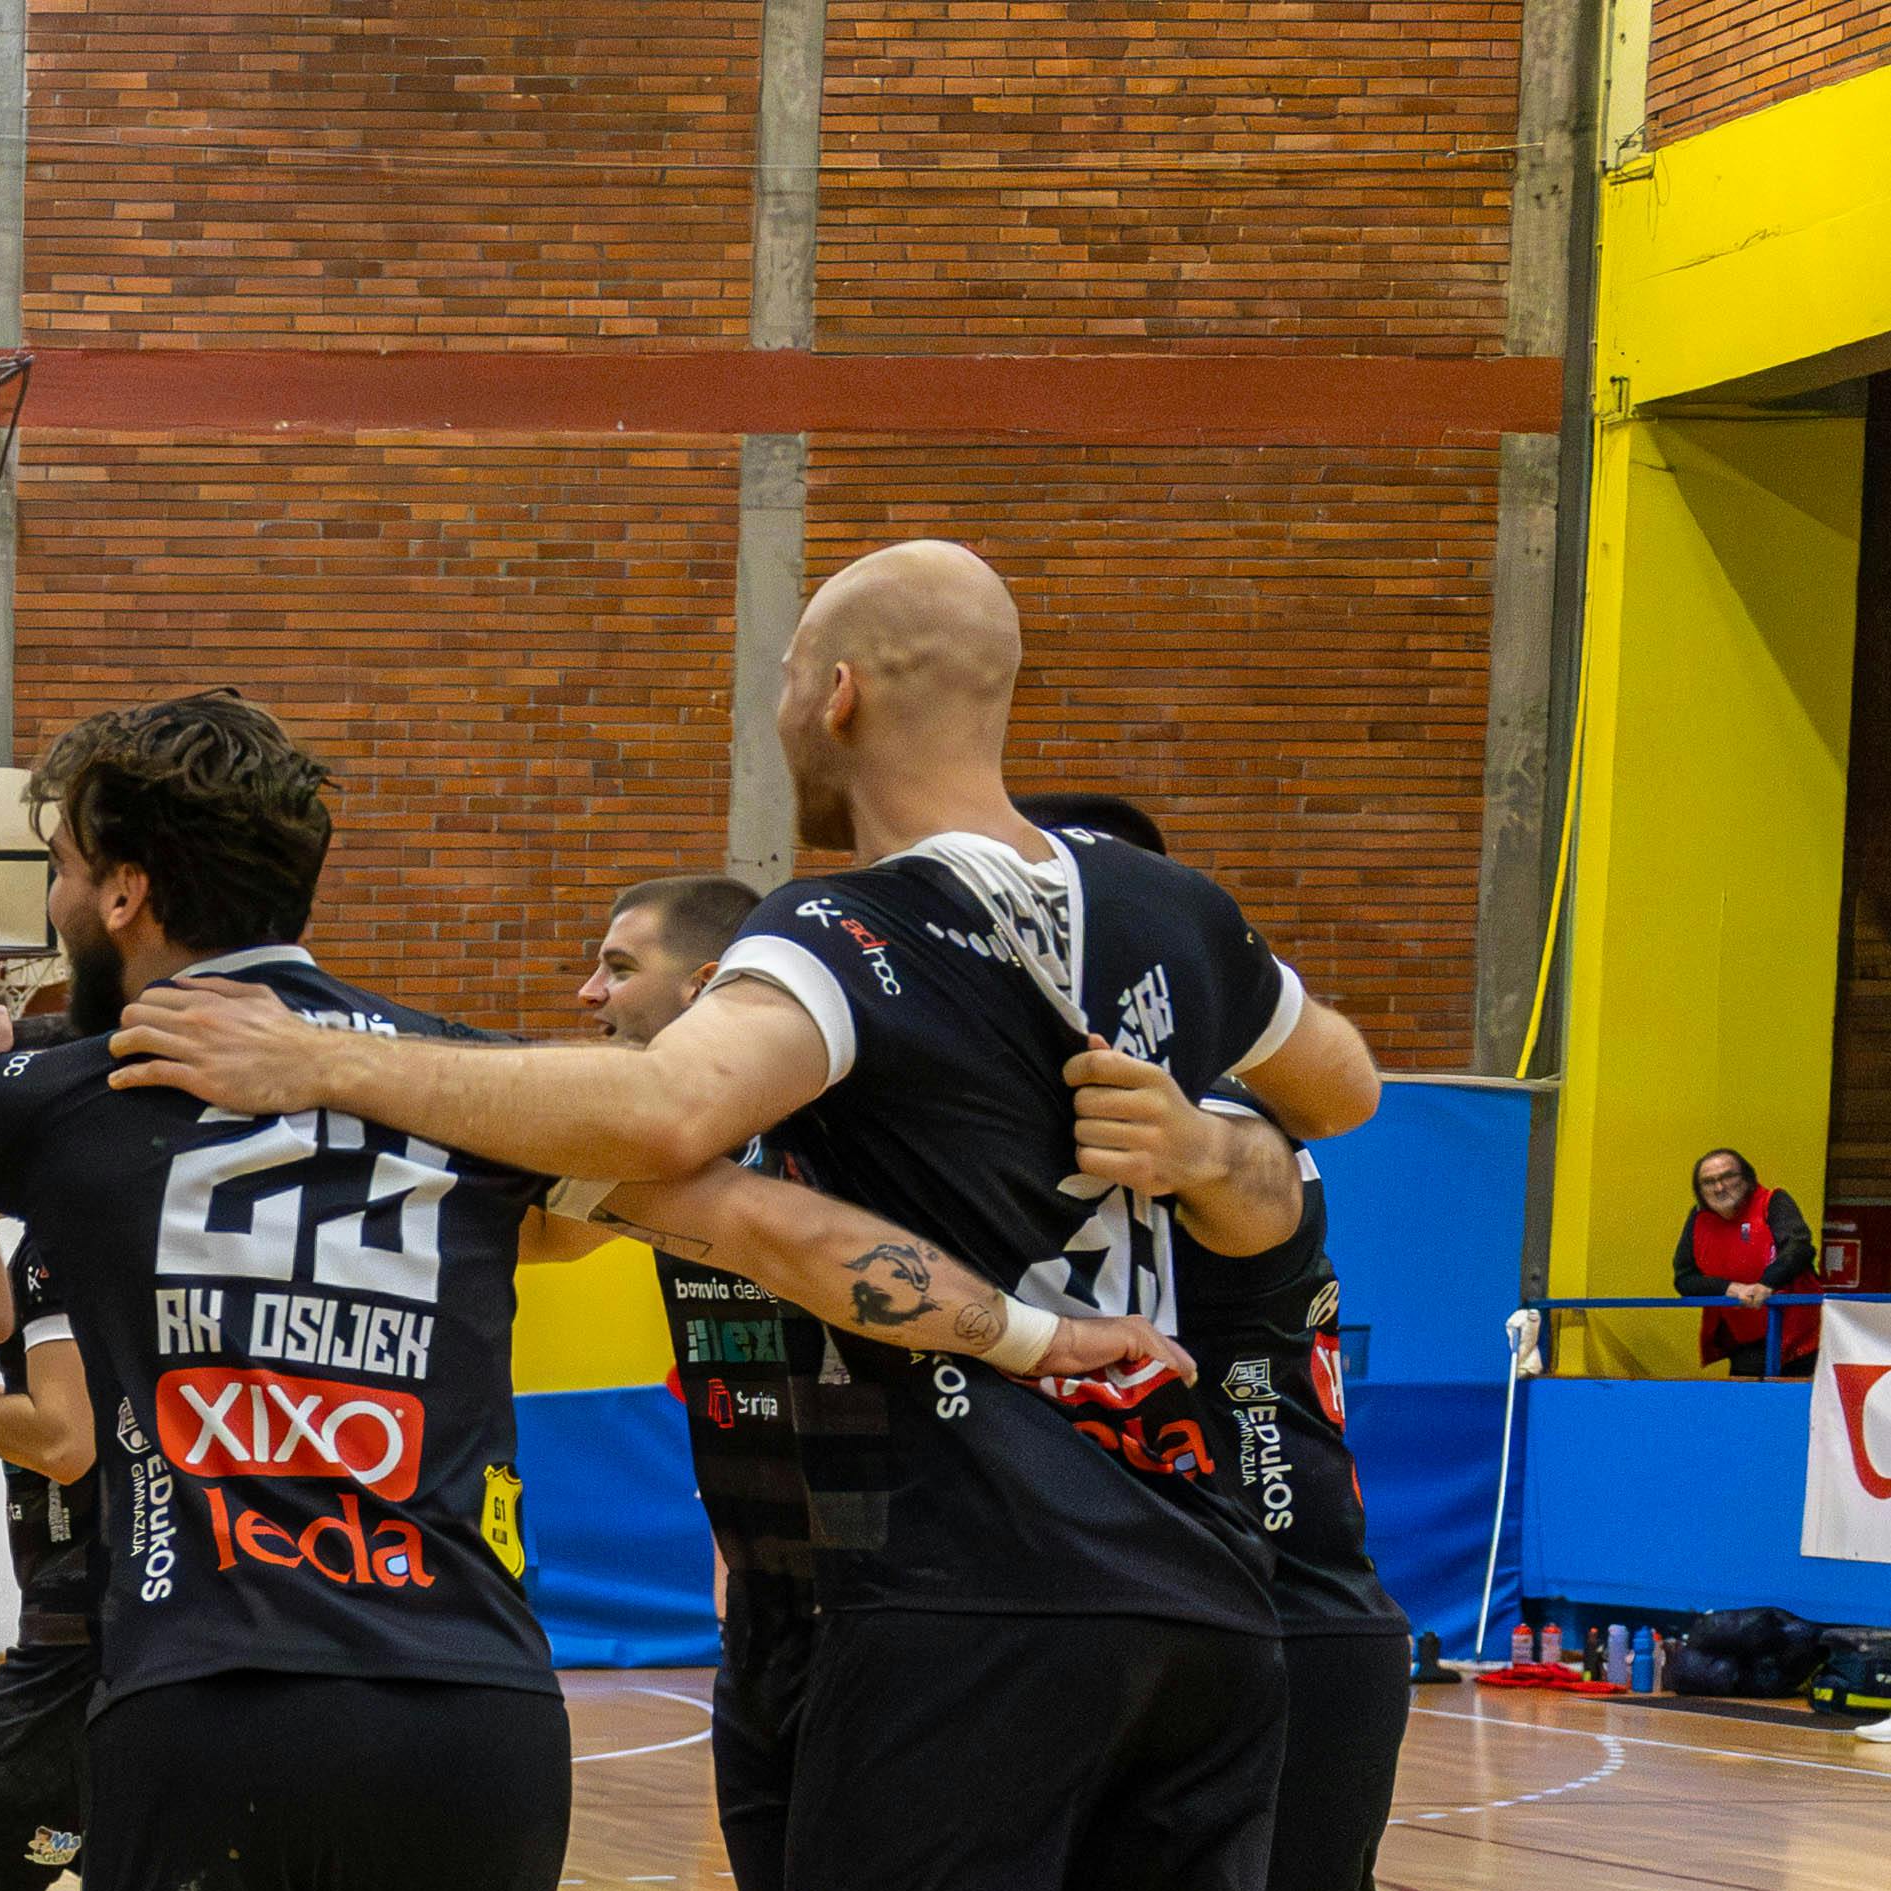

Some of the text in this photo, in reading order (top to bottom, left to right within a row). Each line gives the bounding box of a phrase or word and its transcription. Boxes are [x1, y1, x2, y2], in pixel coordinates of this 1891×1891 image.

[156, 1288, 434, 1380] RK OSIJEK
[178, 1381, 406, 1486] XIXO
[129, 1461, 144, 1558] GIMNAZIJA
[201, 1487, 436, 1590] leda
